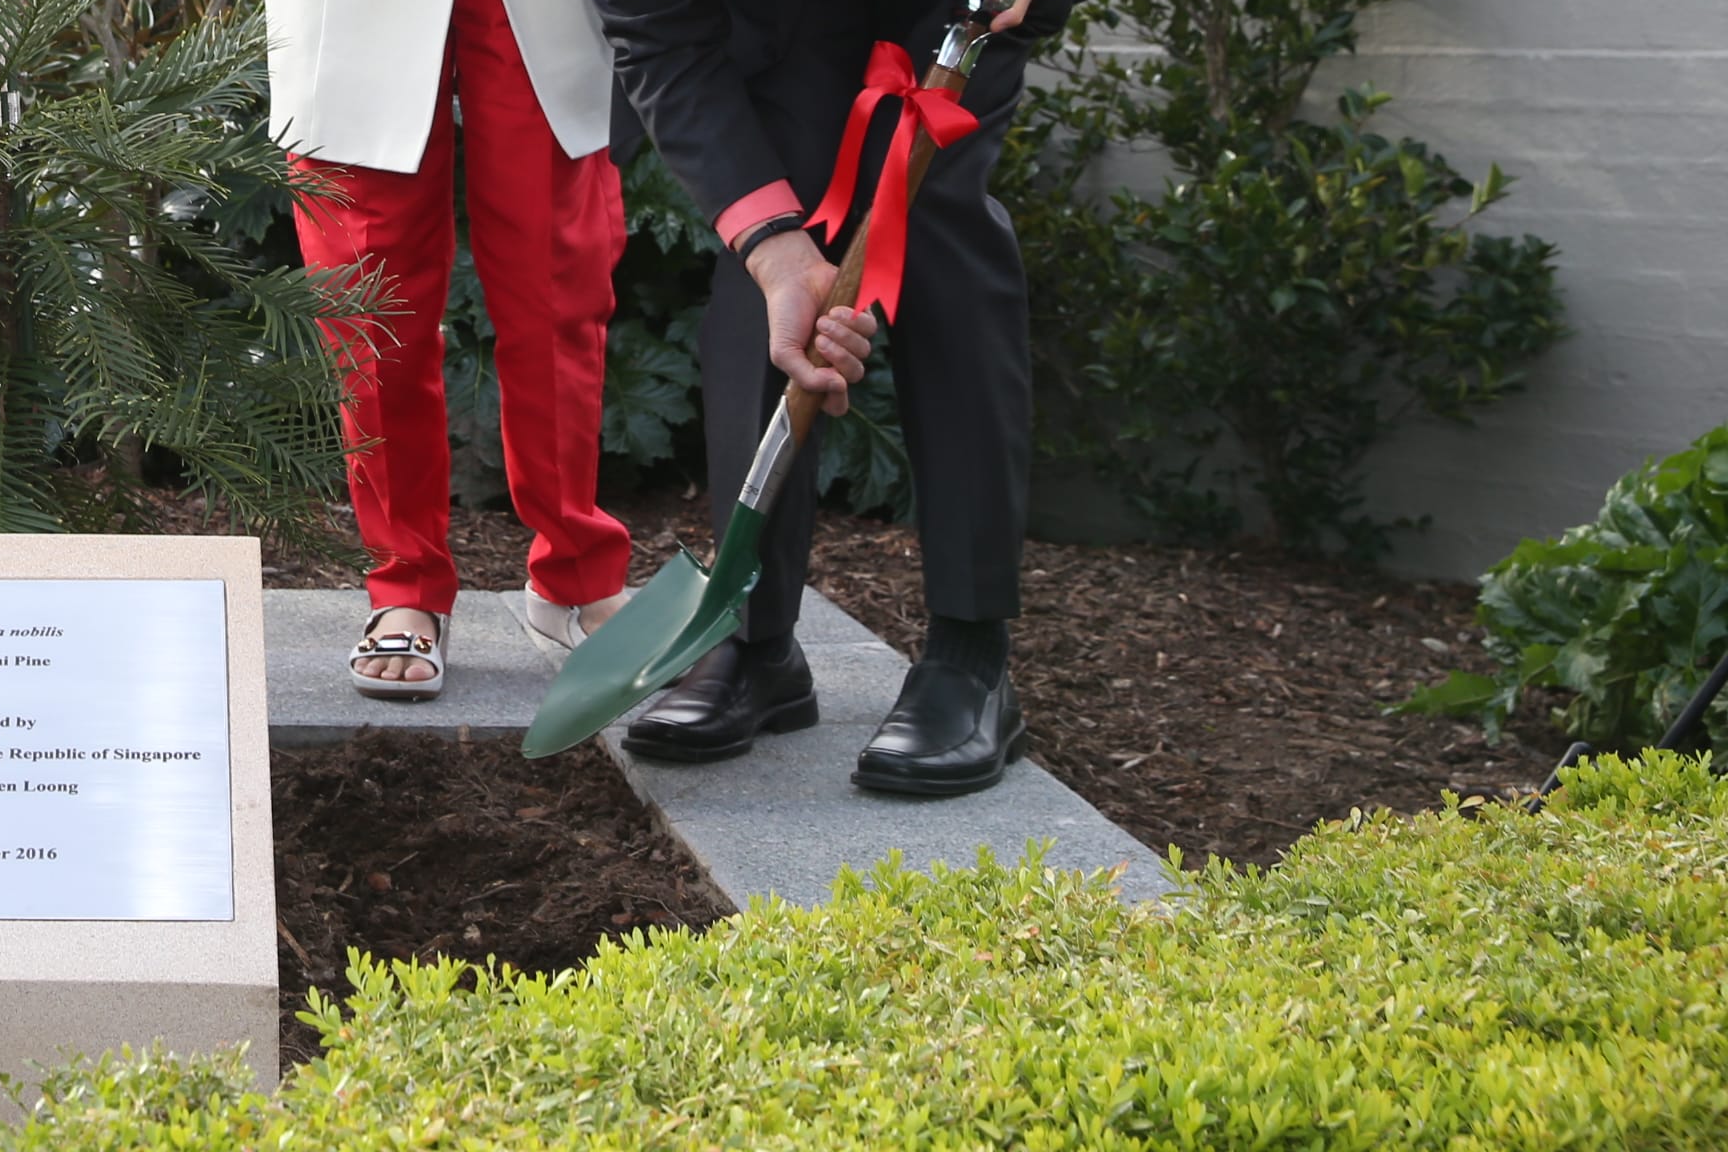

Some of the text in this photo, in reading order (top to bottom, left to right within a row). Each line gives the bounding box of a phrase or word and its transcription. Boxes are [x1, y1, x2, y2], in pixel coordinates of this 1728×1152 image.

[8, 626, 65, 637] nobilis
[13, 655, 52, 667] Pine
[14, 716, 38, 731] by
[8, 747, 87, 763] Republic
[91, 748, 111, 760] of
[112, 748, 203, 764] Singapore
[22, 780, 80, 796] Loong
[14, 847, 59, 860] 2016
